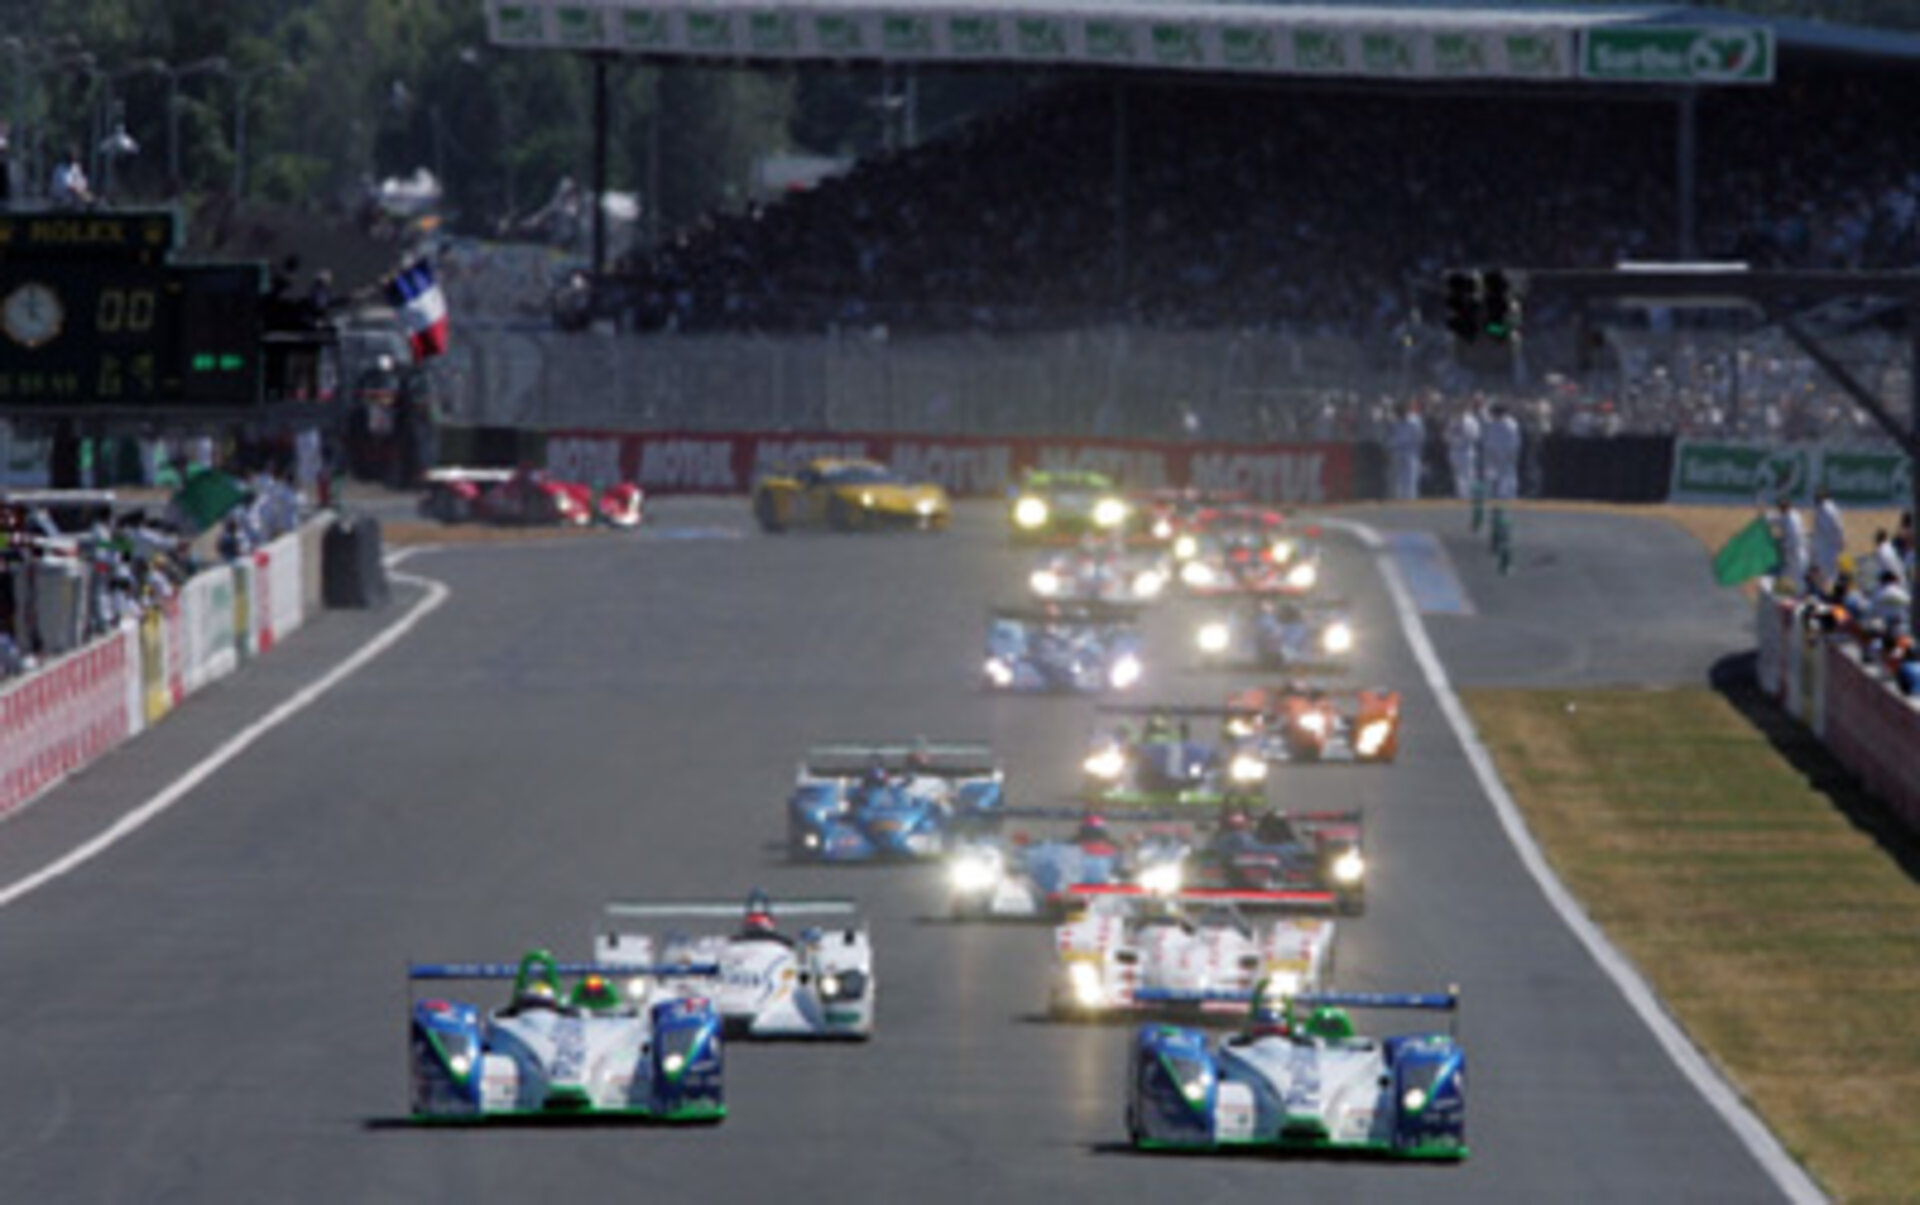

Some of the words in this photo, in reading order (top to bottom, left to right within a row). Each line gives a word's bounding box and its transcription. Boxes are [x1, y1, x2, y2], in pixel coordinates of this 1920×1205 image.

[28, 220, 125, 243] ROLEX
[638, 440, 735, 488] MOTUL
[888, 443, 1011, 494] MOTUL
[1190, 450, 1326, 503] MOTUL
